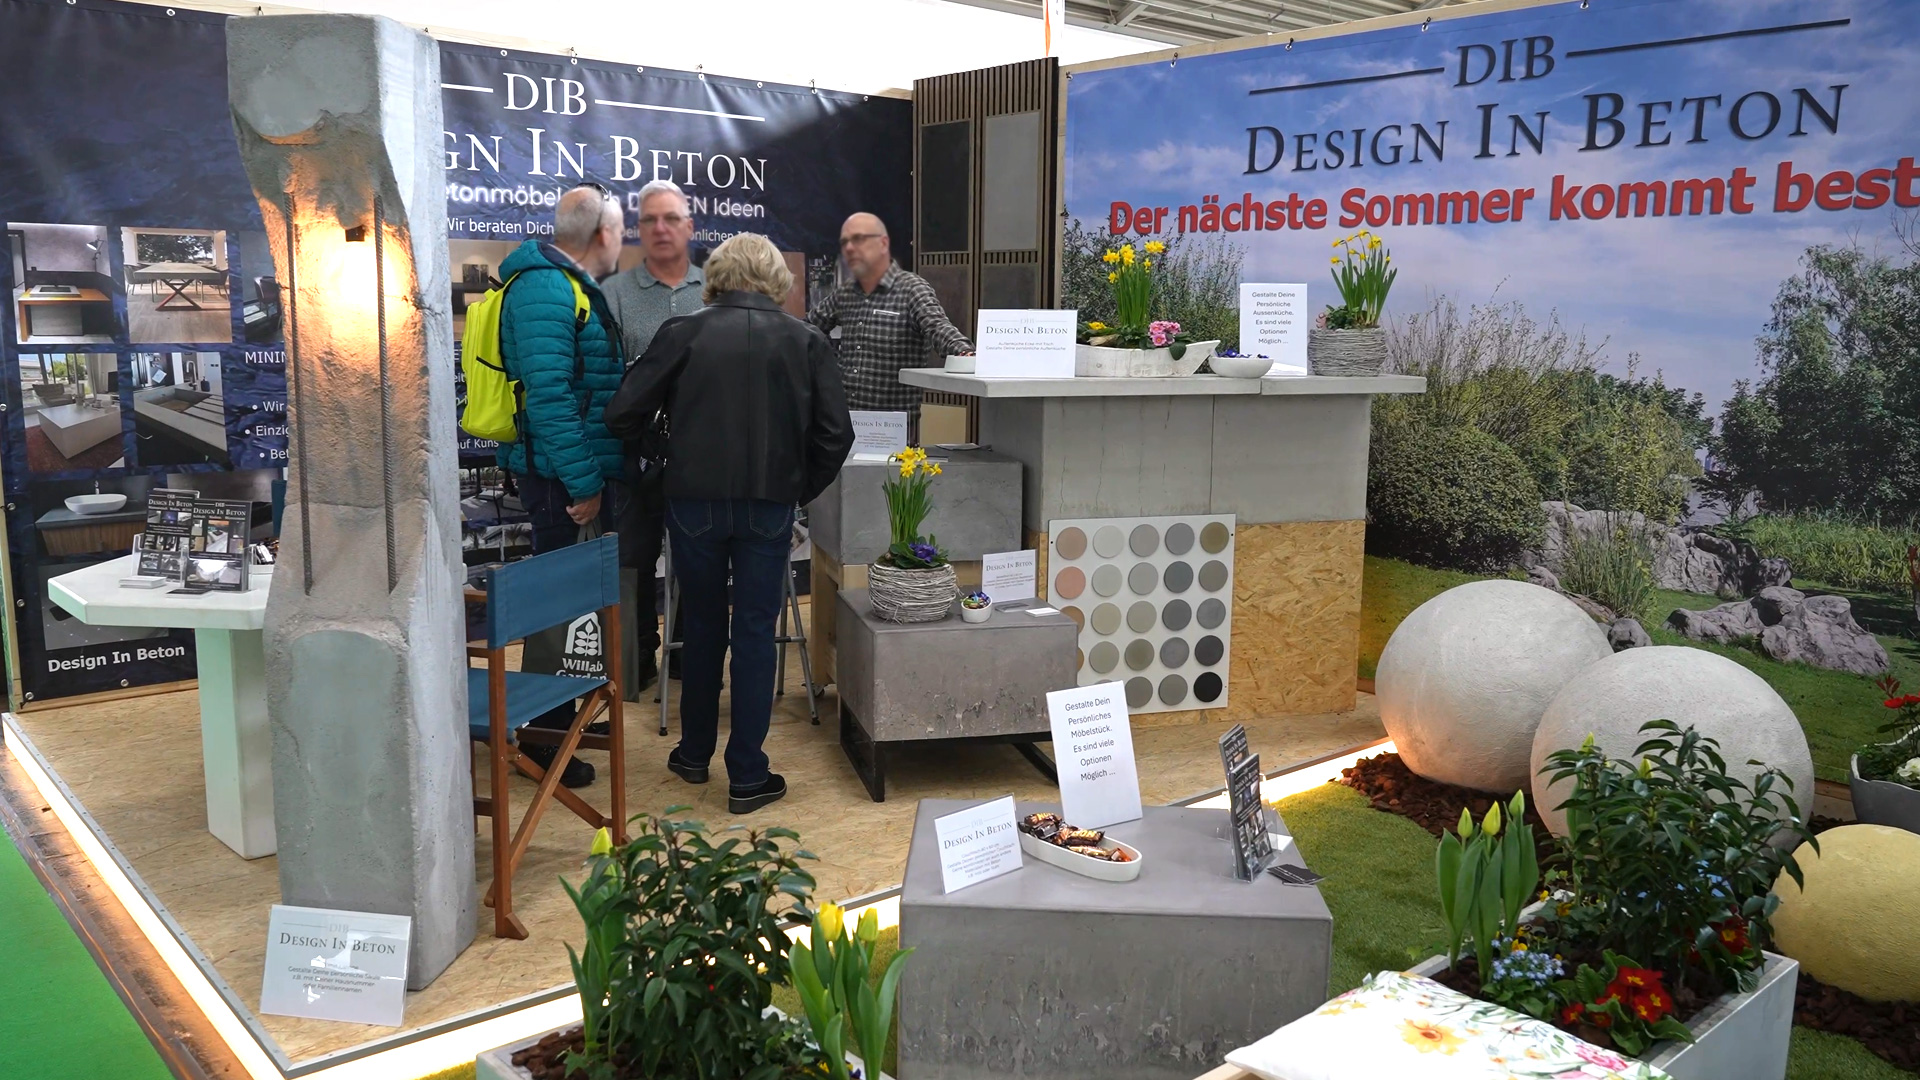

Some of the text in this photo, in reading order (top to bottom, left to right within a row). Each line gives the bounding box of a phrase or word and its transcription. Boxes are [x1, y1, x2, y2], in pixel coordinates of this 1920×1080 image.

[1453, 35, 1556, 88] DIB
[503, 73, 588, 116] DIB
[1243, 84, 1849, 175] DESIGN IN BETON
[527, 128, 588, 179] IN
[609, 135, 768, 191] BETON
[713, 197, 765, 218] Ideen
[1110, 201, 1169, 235] Der
[1178, 192, 1328, 233] nächste
[1339, 187, 1535, 230] Sommer
[1550, 167, 1757, 221] kommt
[469, 217, 522, 234] beraten
[526, 220, 555, 235] Dich
[262, 401, 284, 412] Wir
[474, 438, 500, 448] Kuns
[48, 645, 186, 672] Design In Beton
[562, 658, 604, 672] Willab
[1065, 697, 1110, 712] Gestalte Dein
[1068, 712, 1112, 725] Persönliches
[1073, 739, 1114, 753] Es sind viele
[1080, 754, 1112, 767] Optionen
[1080, 769, 1108, 781] Möglich
[280, 932, 396, 954] DESIGN IN BETON
